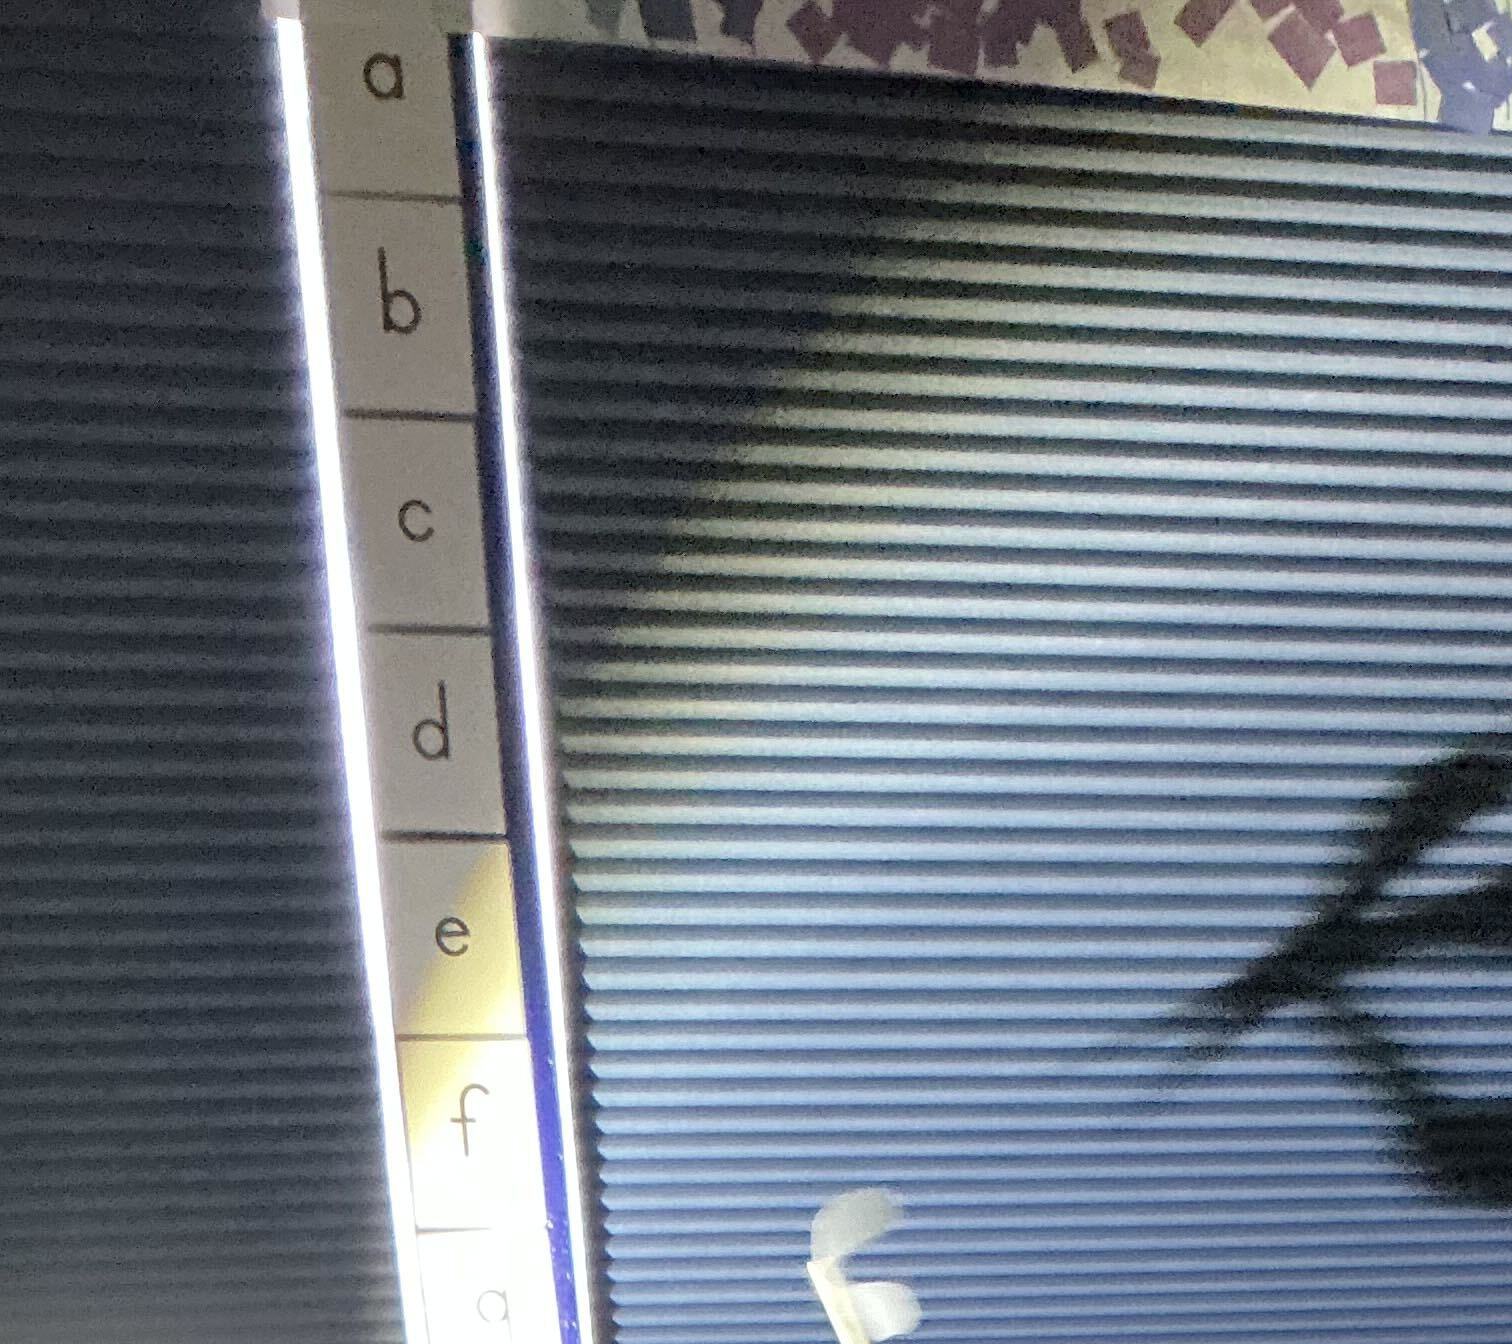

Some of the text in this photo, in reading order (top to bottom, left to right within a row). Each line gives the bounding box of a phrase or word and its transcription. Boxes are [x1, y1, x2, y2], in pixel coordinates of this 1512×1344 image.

[363, 52, 405, 99] a
[377, 247, 422, 334] b
[397, 498, 434, 542] c
[411, 680, 450, 760] d
[434, 914, 471, 957] e
[450, 1082, 490, 1157] f
